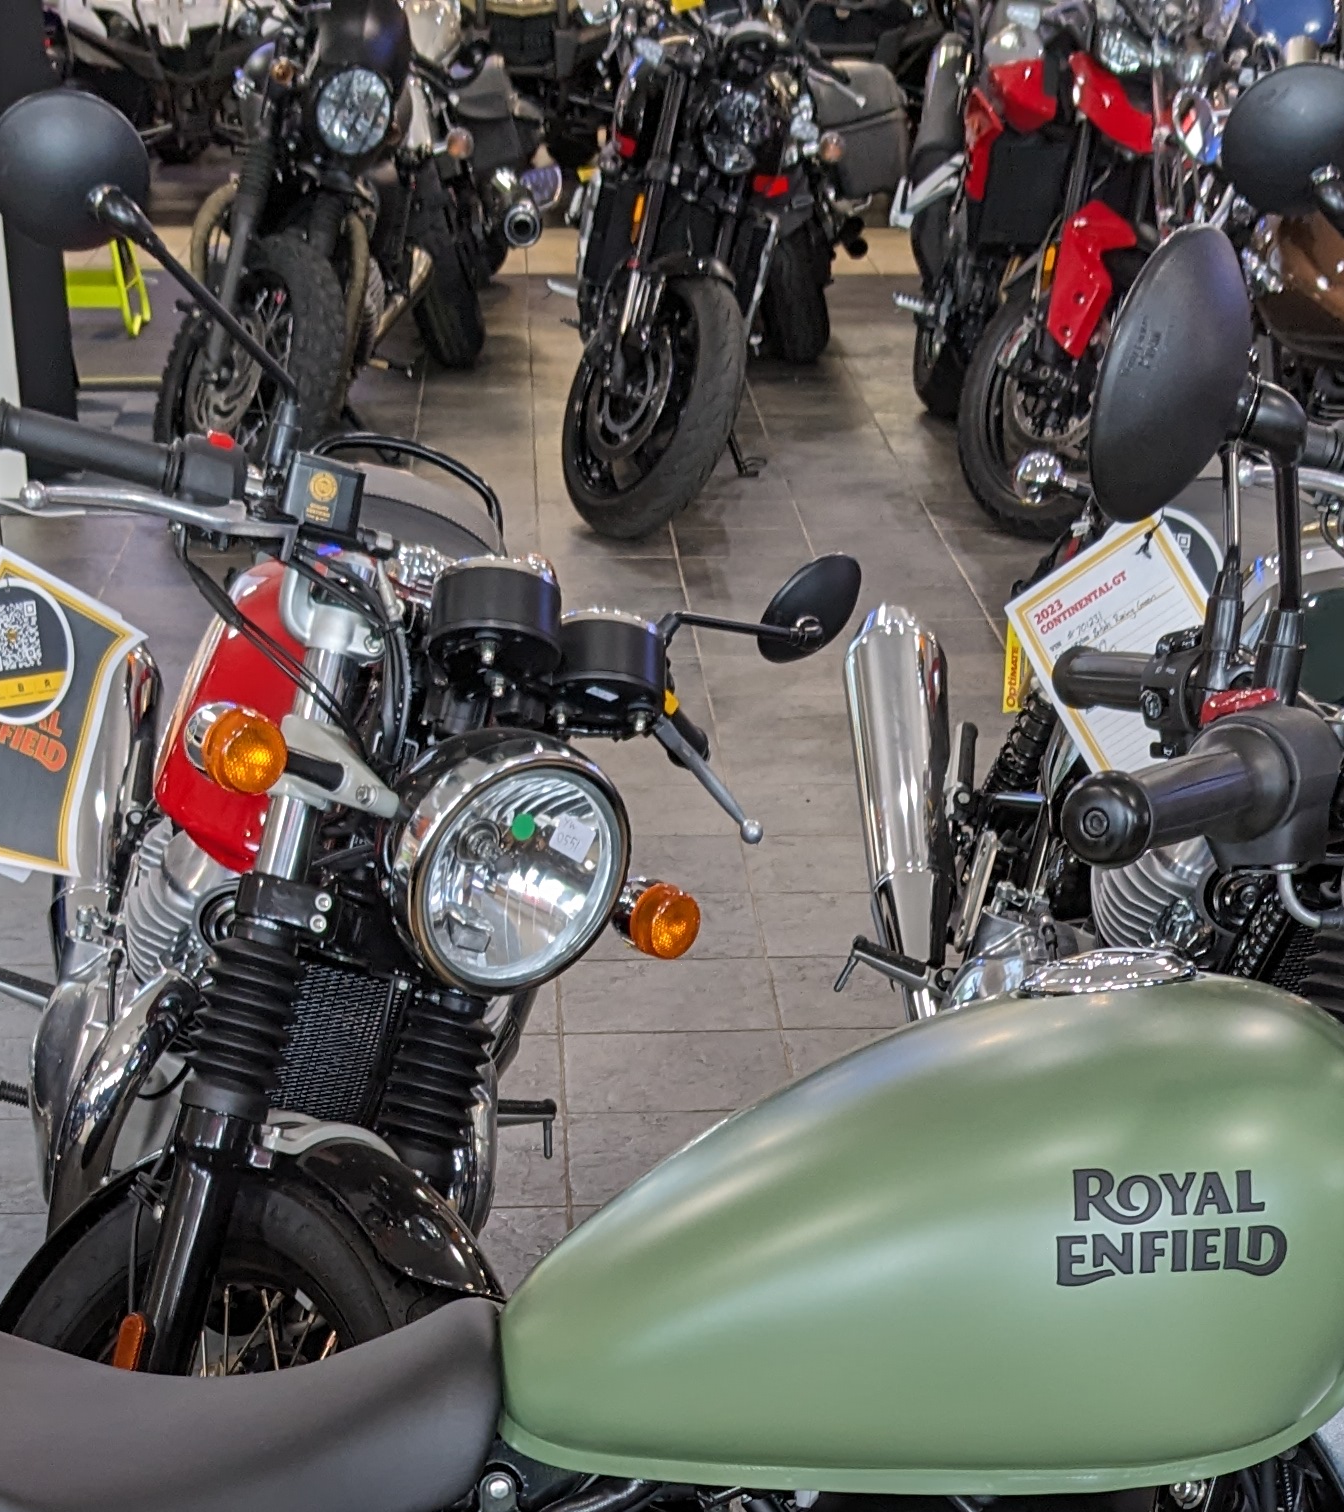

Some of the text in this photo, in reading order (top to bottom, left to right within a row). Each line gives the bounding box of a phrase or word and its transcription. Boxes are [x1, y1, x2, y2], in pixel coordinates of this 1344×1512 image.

[1033, 598, 1065, 626] 2023
[1039, 569, 1129, 636] CONTINENTAL GT
[1072, 1168, 1266, 1226] ROYAL
[1055, 1224, 1288, 1287] ENFIELD
